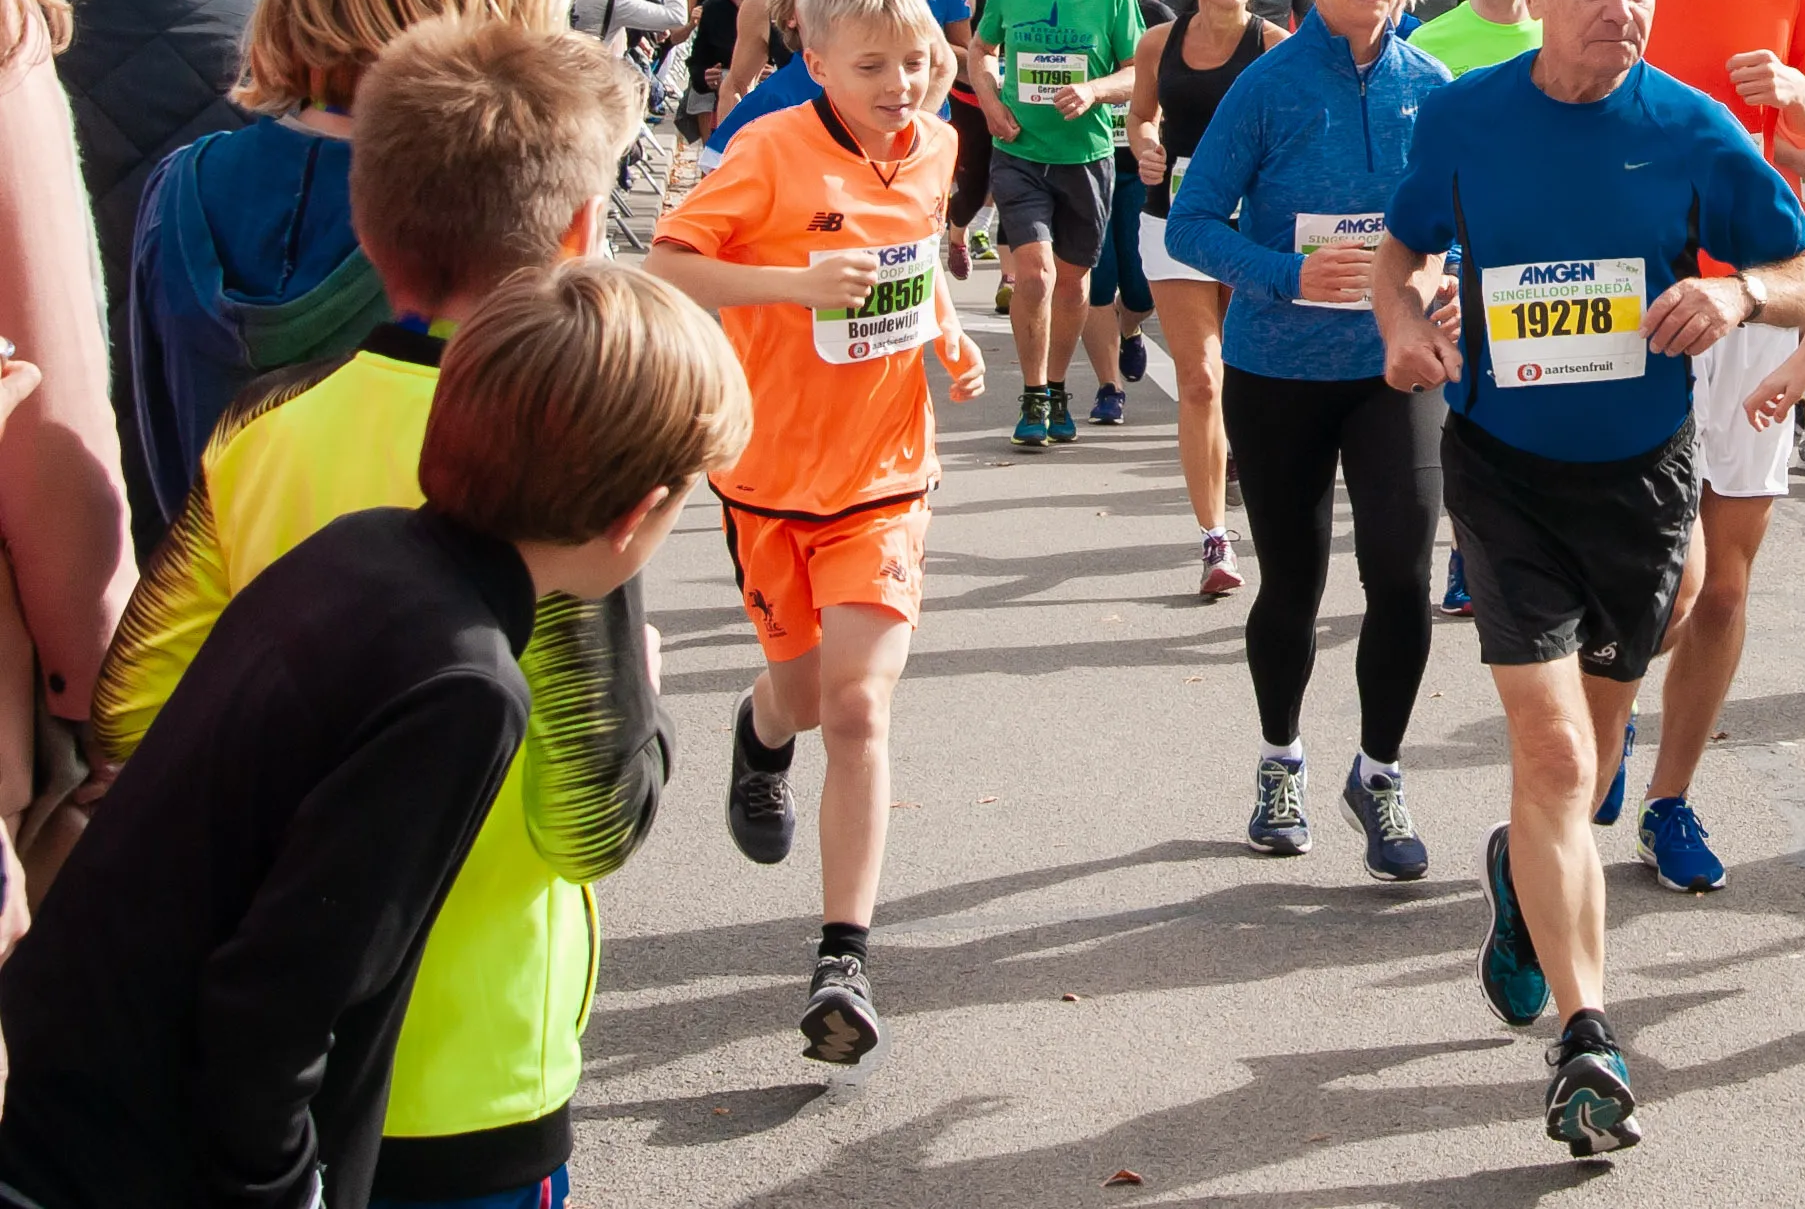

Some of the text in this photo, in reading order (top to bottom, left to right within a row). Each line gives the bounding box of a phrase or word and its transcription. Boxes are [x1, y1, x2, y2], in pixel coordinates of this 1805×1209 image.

[1033, 55, 1067, 64] AMGEN
[1030, 70, 1072, 85] 11796
[1519, 262, 1596, 286] AMGEN
[1492, 282, 1634, 303] SINGELLOOP BREDA
[848, 311, 920, 339] Boudewijn
[1511, 297, 1613, 339] 19278
[1544, 361, 1614, 376] aartsenfruit
